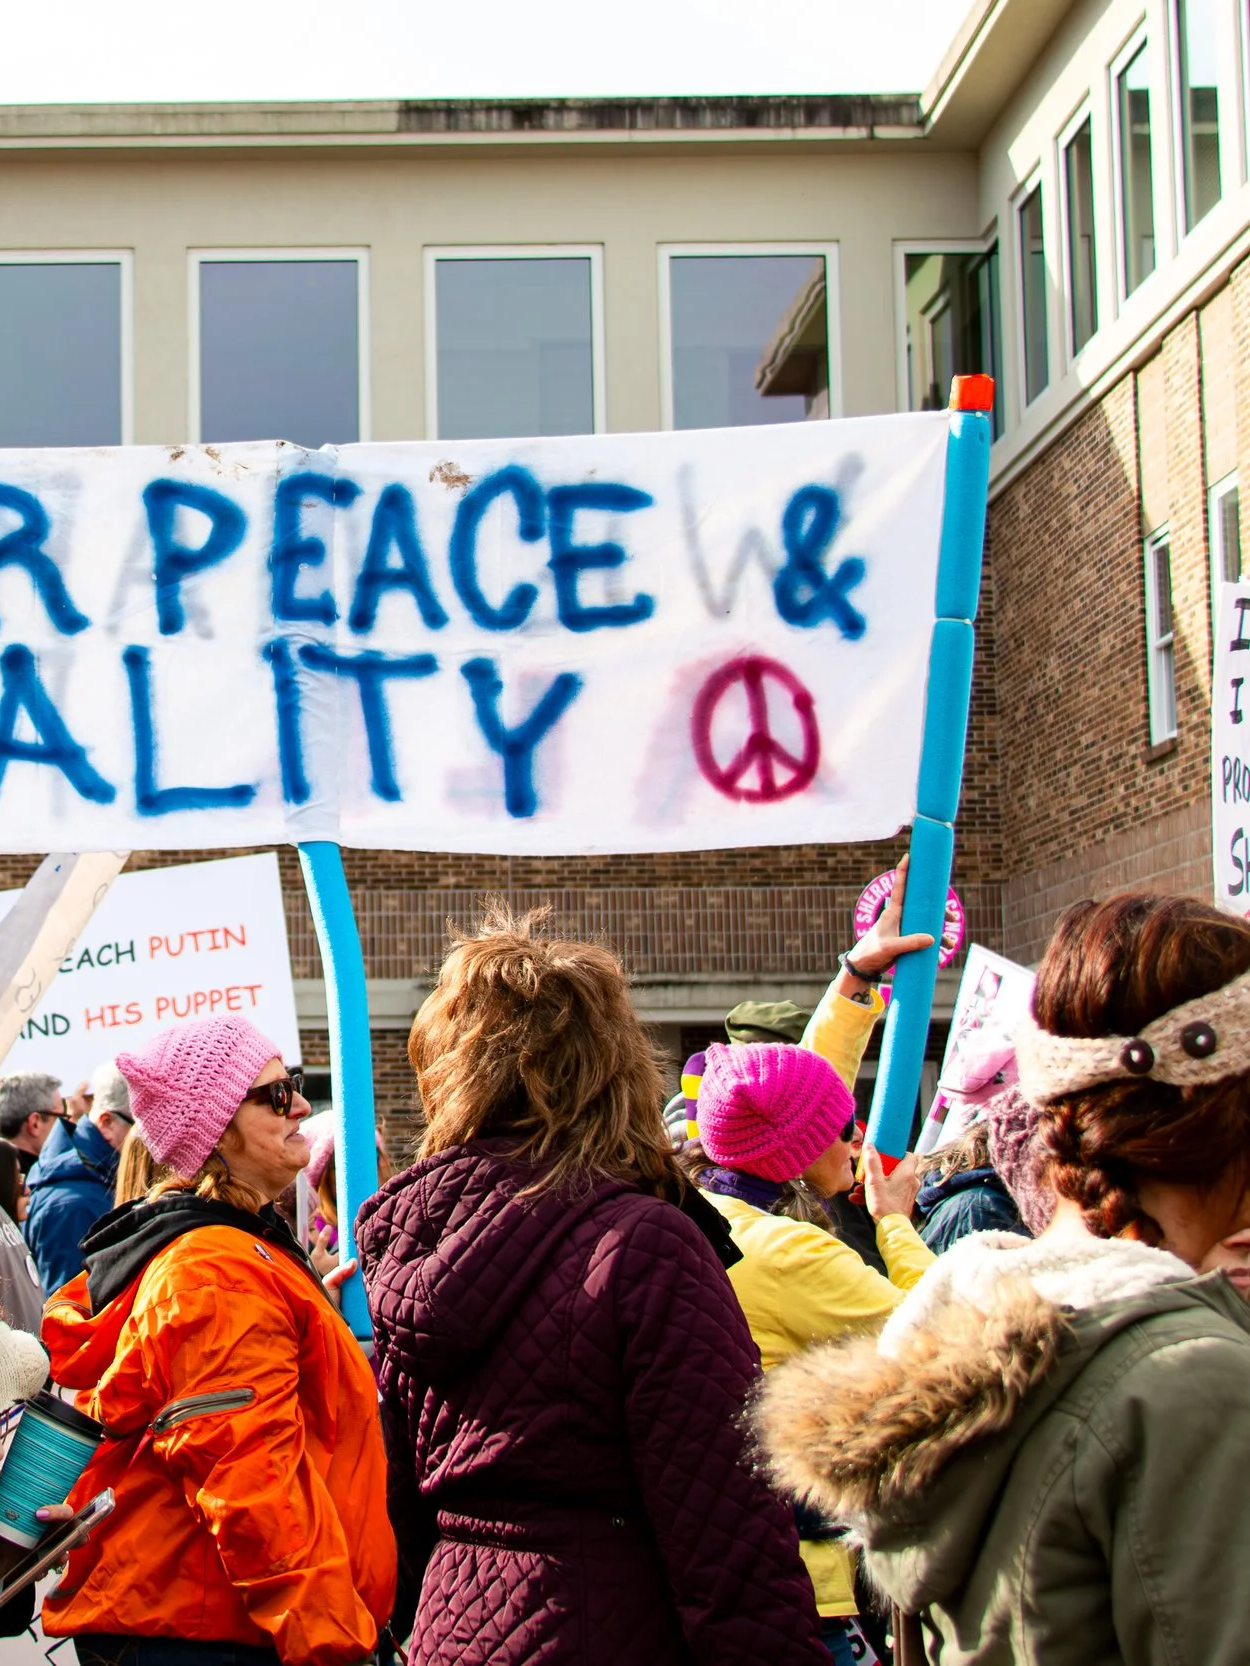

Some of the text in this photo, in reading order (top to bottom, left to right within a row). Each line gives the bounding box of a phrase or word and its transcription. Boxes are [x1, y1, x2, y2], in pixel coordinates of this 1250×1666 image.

[143, 463, 655, 635] PEACE
[772, 483, 867, 641] &
[148, 923, 247, 959] PUTIN
[85, 1002, 143, 1031] HIS
[155, 983, 263, 1021] PUPPET
